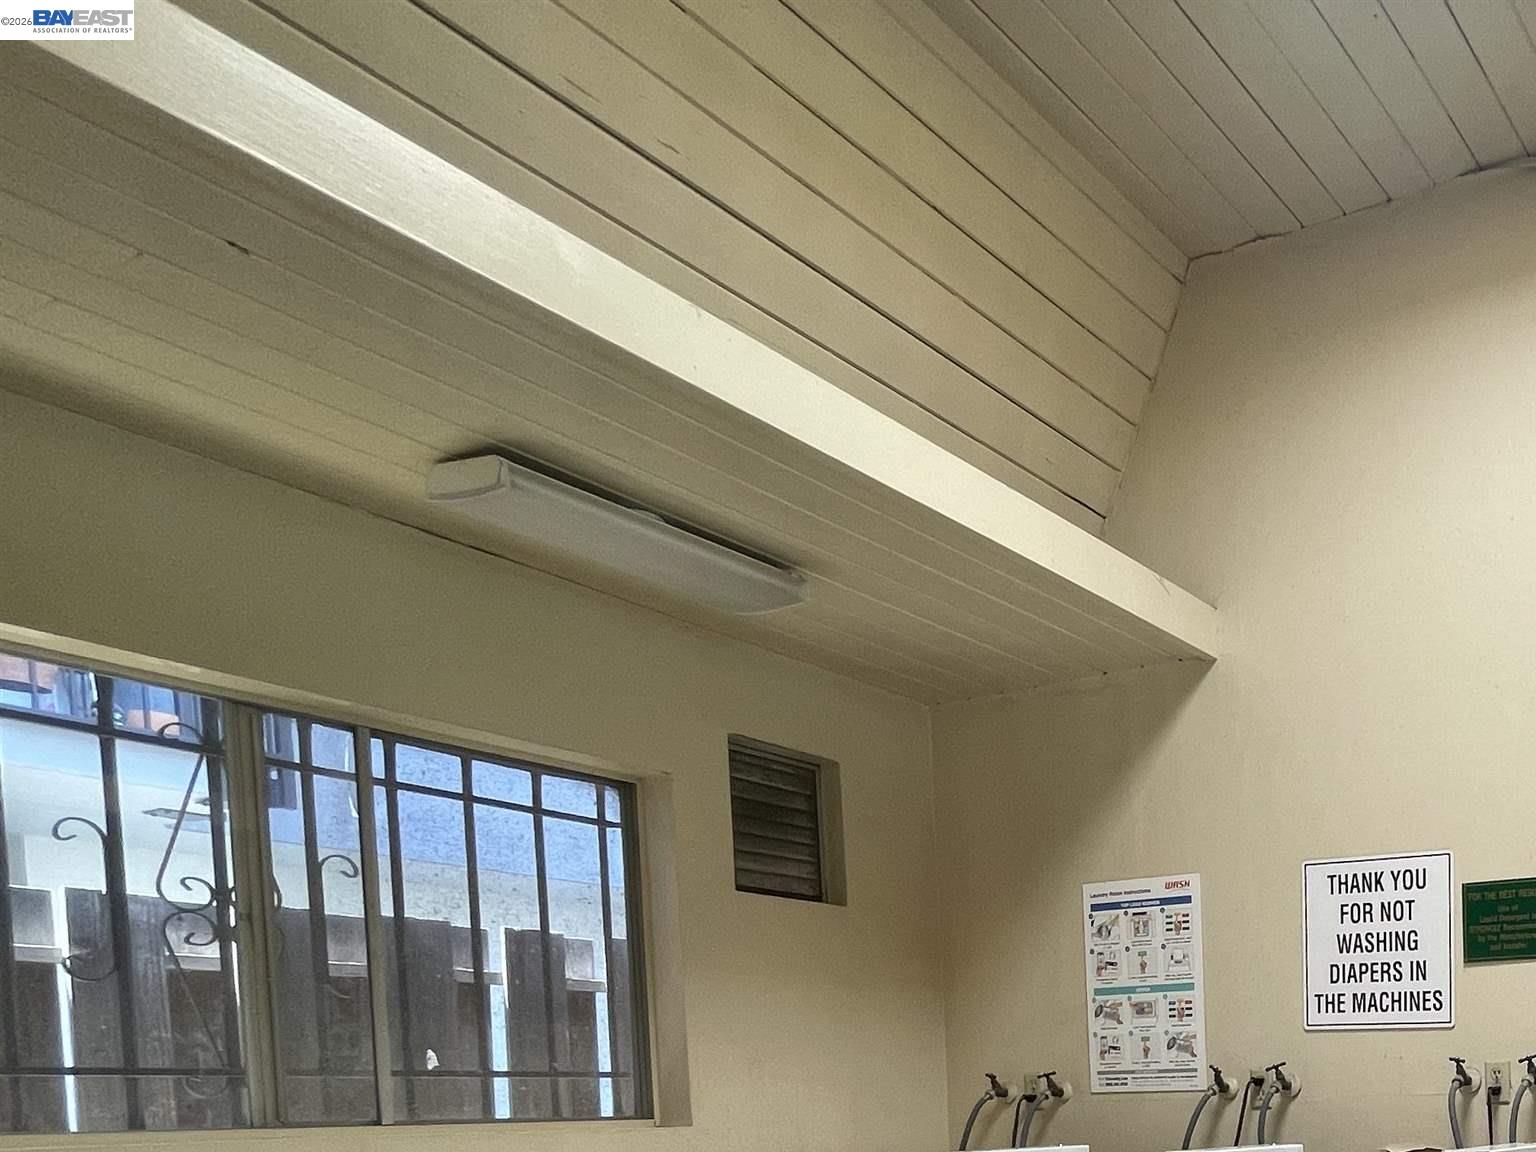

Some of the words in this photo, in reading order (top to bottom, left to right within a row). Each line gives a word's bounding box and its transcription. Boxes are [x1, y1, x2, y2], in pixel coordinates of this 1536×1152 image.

[1327, 871, 1385, 895] THANK
[1390, 868, 1427, 890] YOU
[1340, 903, 1374, 924] FOR
[1381, 900, 1415, 922] NOT
[1336, 930, 1419, 954] WASHING
[1329, 962, 1403, 984] DIAPERS
[1410, 960, 1427, 981] IN
[1314, 993, 1346, 1014] THE
[1351, 990, 1443, 1013] MACHINES
